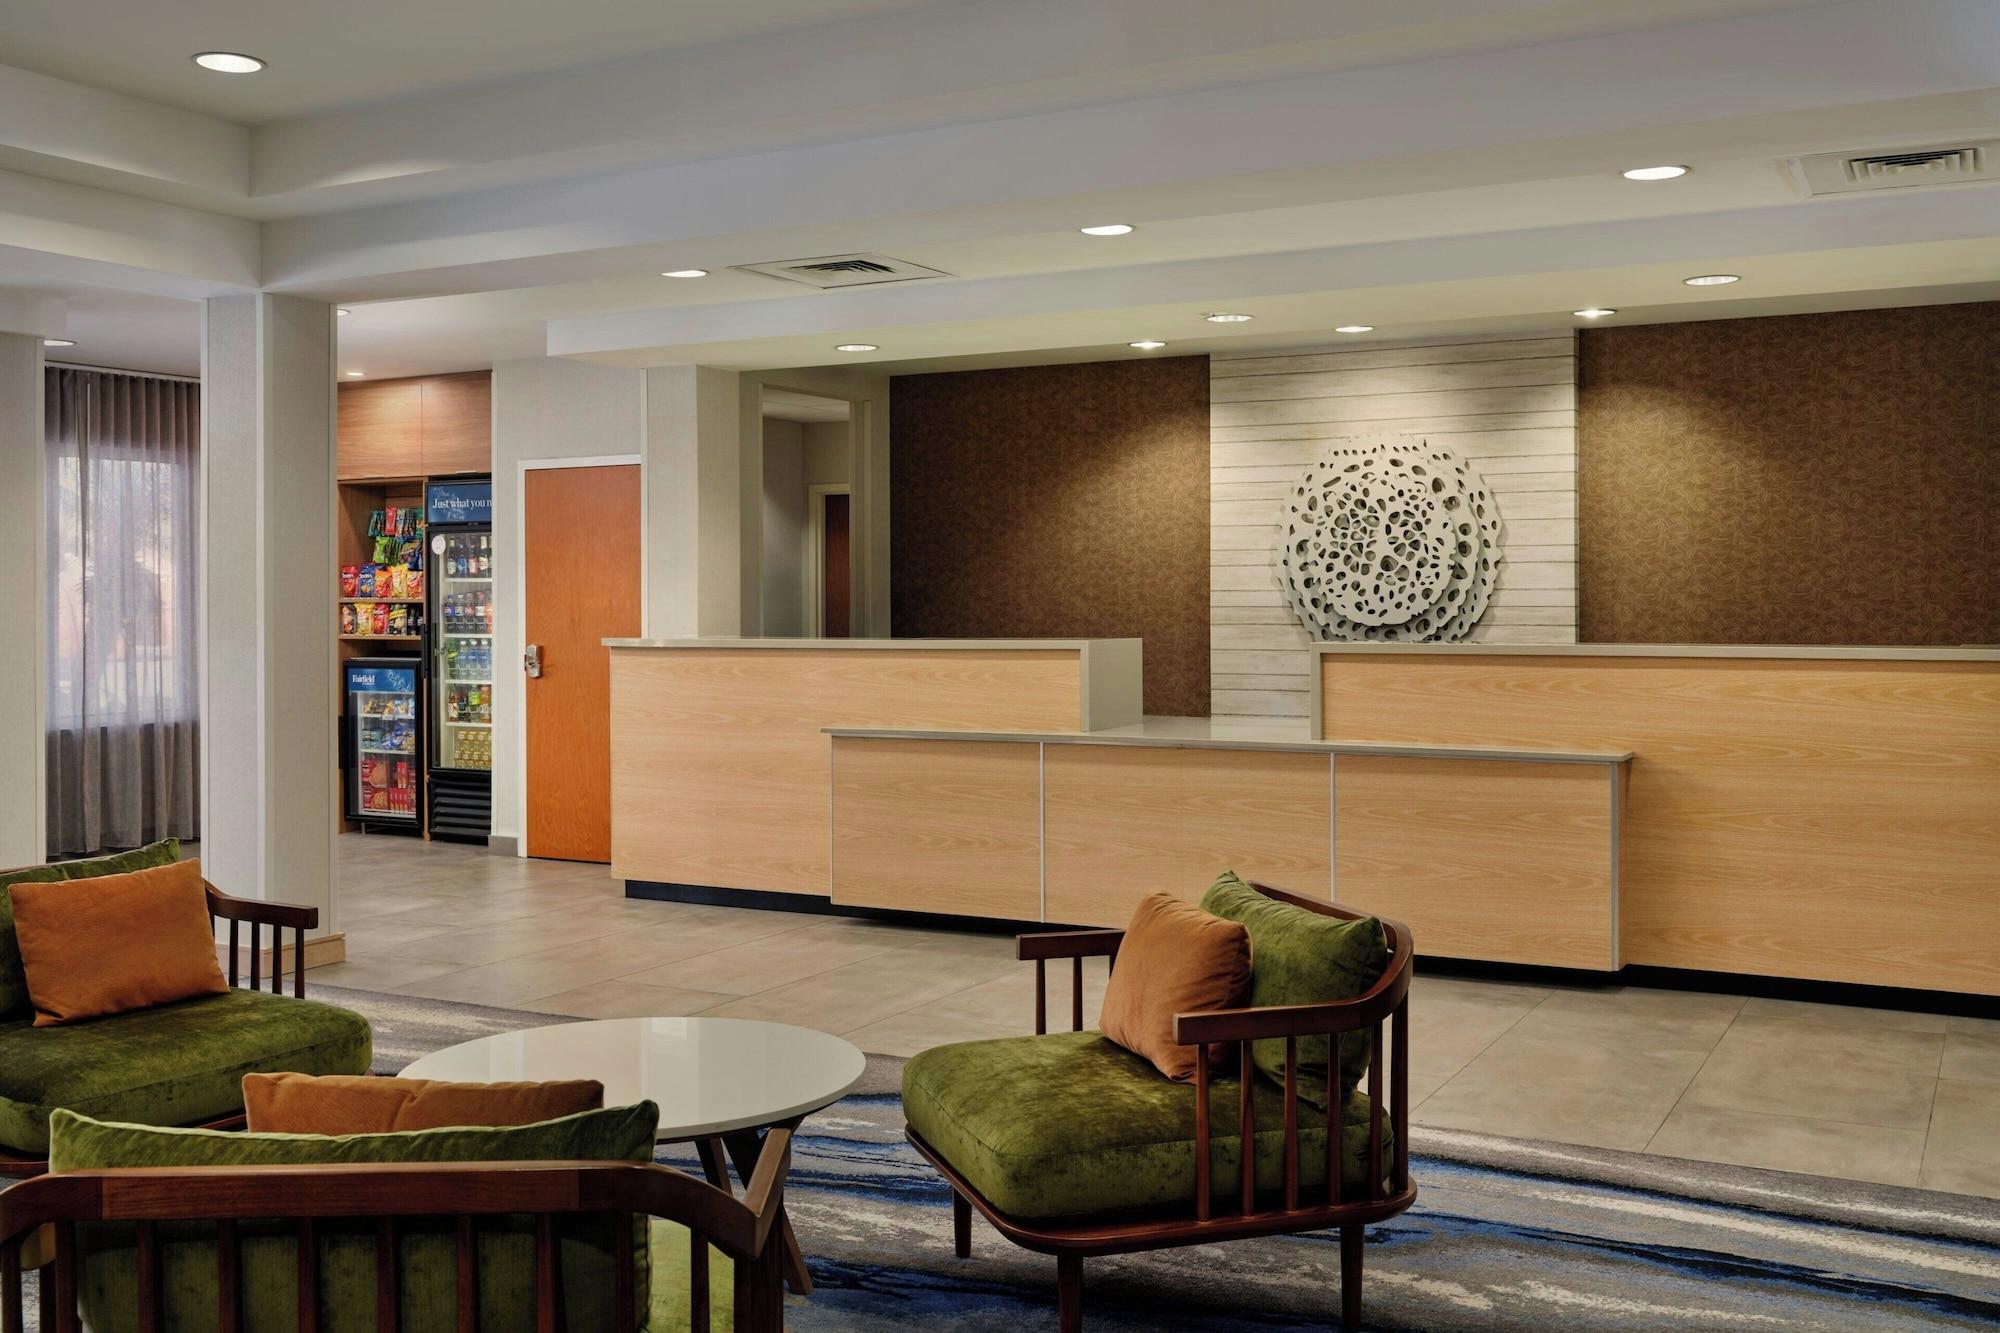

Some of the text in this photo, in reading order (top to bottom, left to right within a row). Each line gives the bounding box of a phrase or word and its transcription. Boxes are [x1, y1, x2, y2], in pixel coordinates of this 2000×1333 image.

[432, 498, 449, 509] Just
[450, 497, 470, 508] what
[470, 499, 486, 510] you
